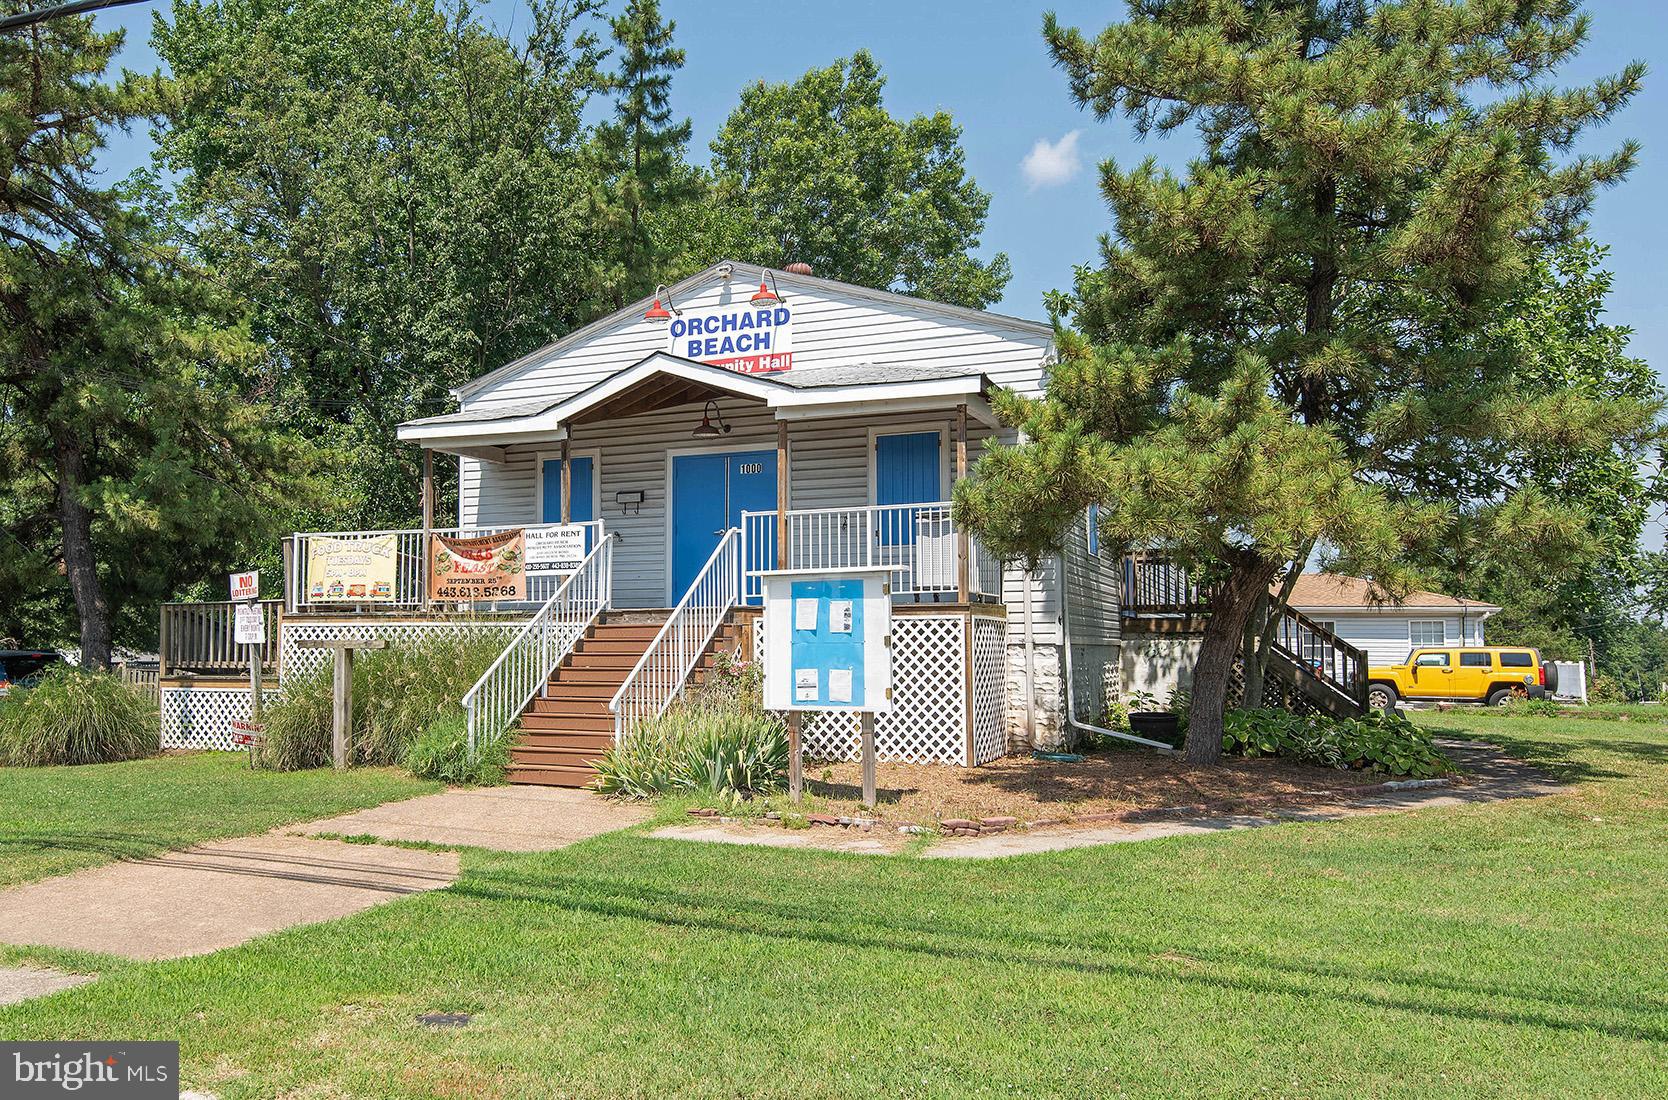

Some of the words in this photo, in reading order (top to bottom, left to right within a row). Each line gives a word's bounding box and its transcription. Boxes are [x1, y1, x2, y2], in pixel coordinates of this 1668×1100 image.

[669, 308, 791, 338] ORCHARD
[687, 331, 771, 357] BEACH
[759, 353, 791, 370] Hall
[741, 463, 762, 474] 1000
[560, 530, 580, 538] RENT
[311, 541, 343, 561] FOOD
[344, 540, 393, 559] TRUCK
[461, 548, 493, 561] CRAB
[326, 555, 372, 567] TUESDAYS
[453, 560, 496, 574] FEAST
[239, 575, 253, 588] NO
[232, 586, 258, 597] LOITERING
